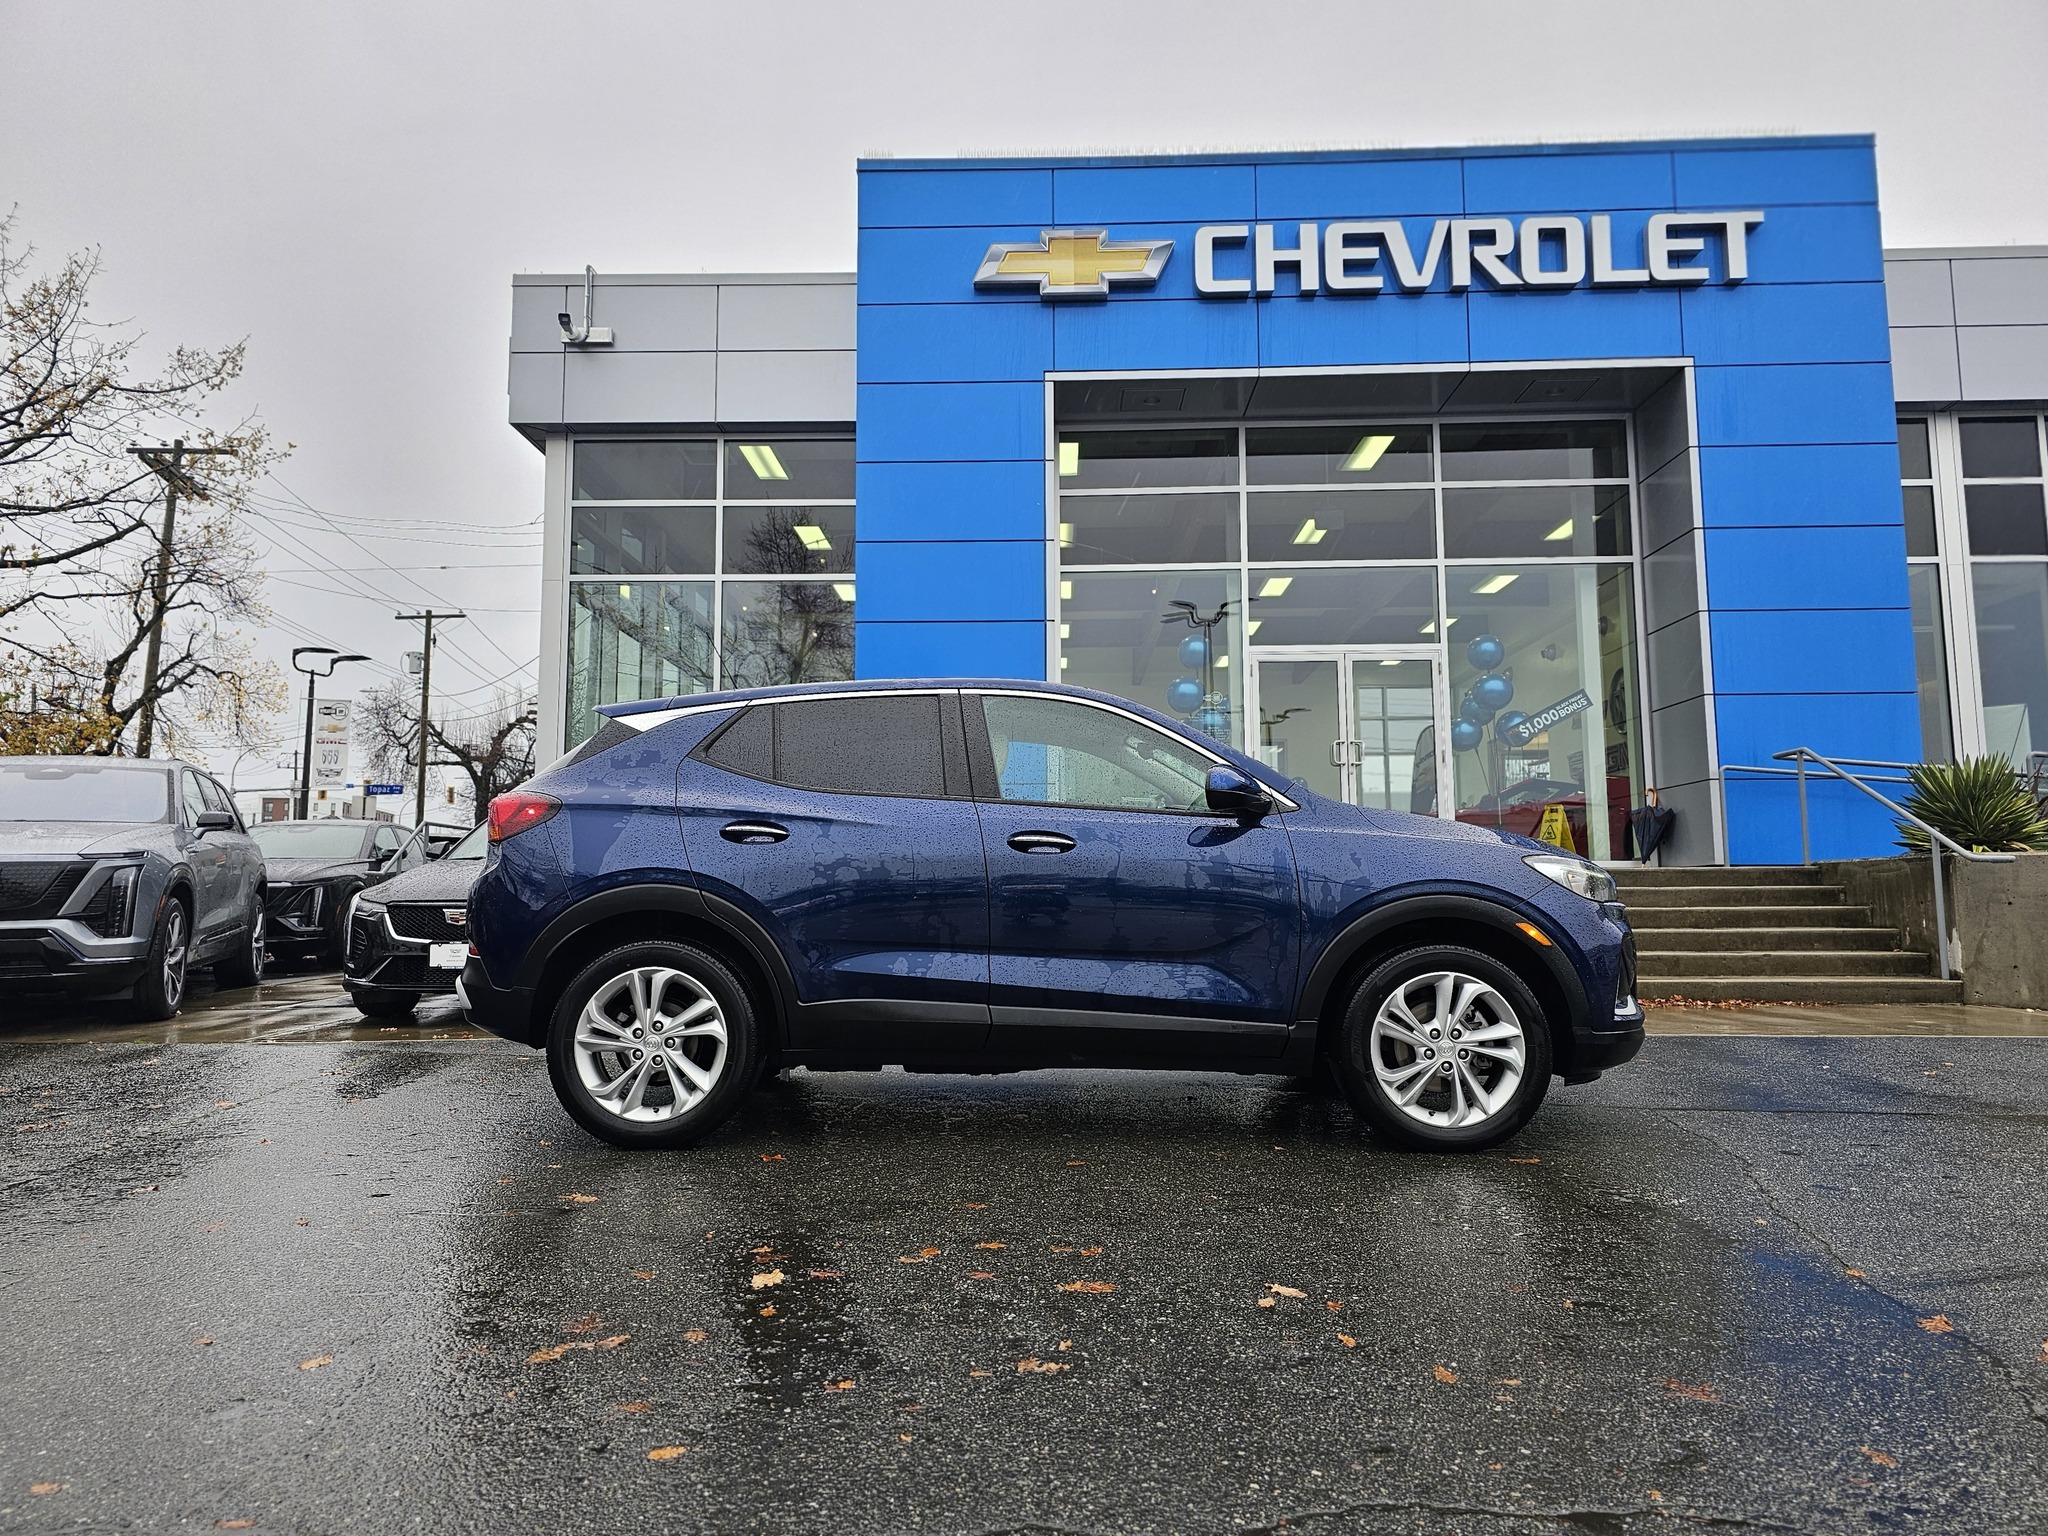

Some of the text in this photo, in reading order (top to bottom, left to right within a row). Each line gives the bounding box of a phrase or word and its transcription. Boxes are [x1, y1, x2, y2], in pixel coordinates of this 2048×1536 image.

[1195, 211, 1765, 293] CHEVROLET
[1519, 697, 1588, 738] $1,000 BONUS
[369, 785, 390, 793] Topaz
